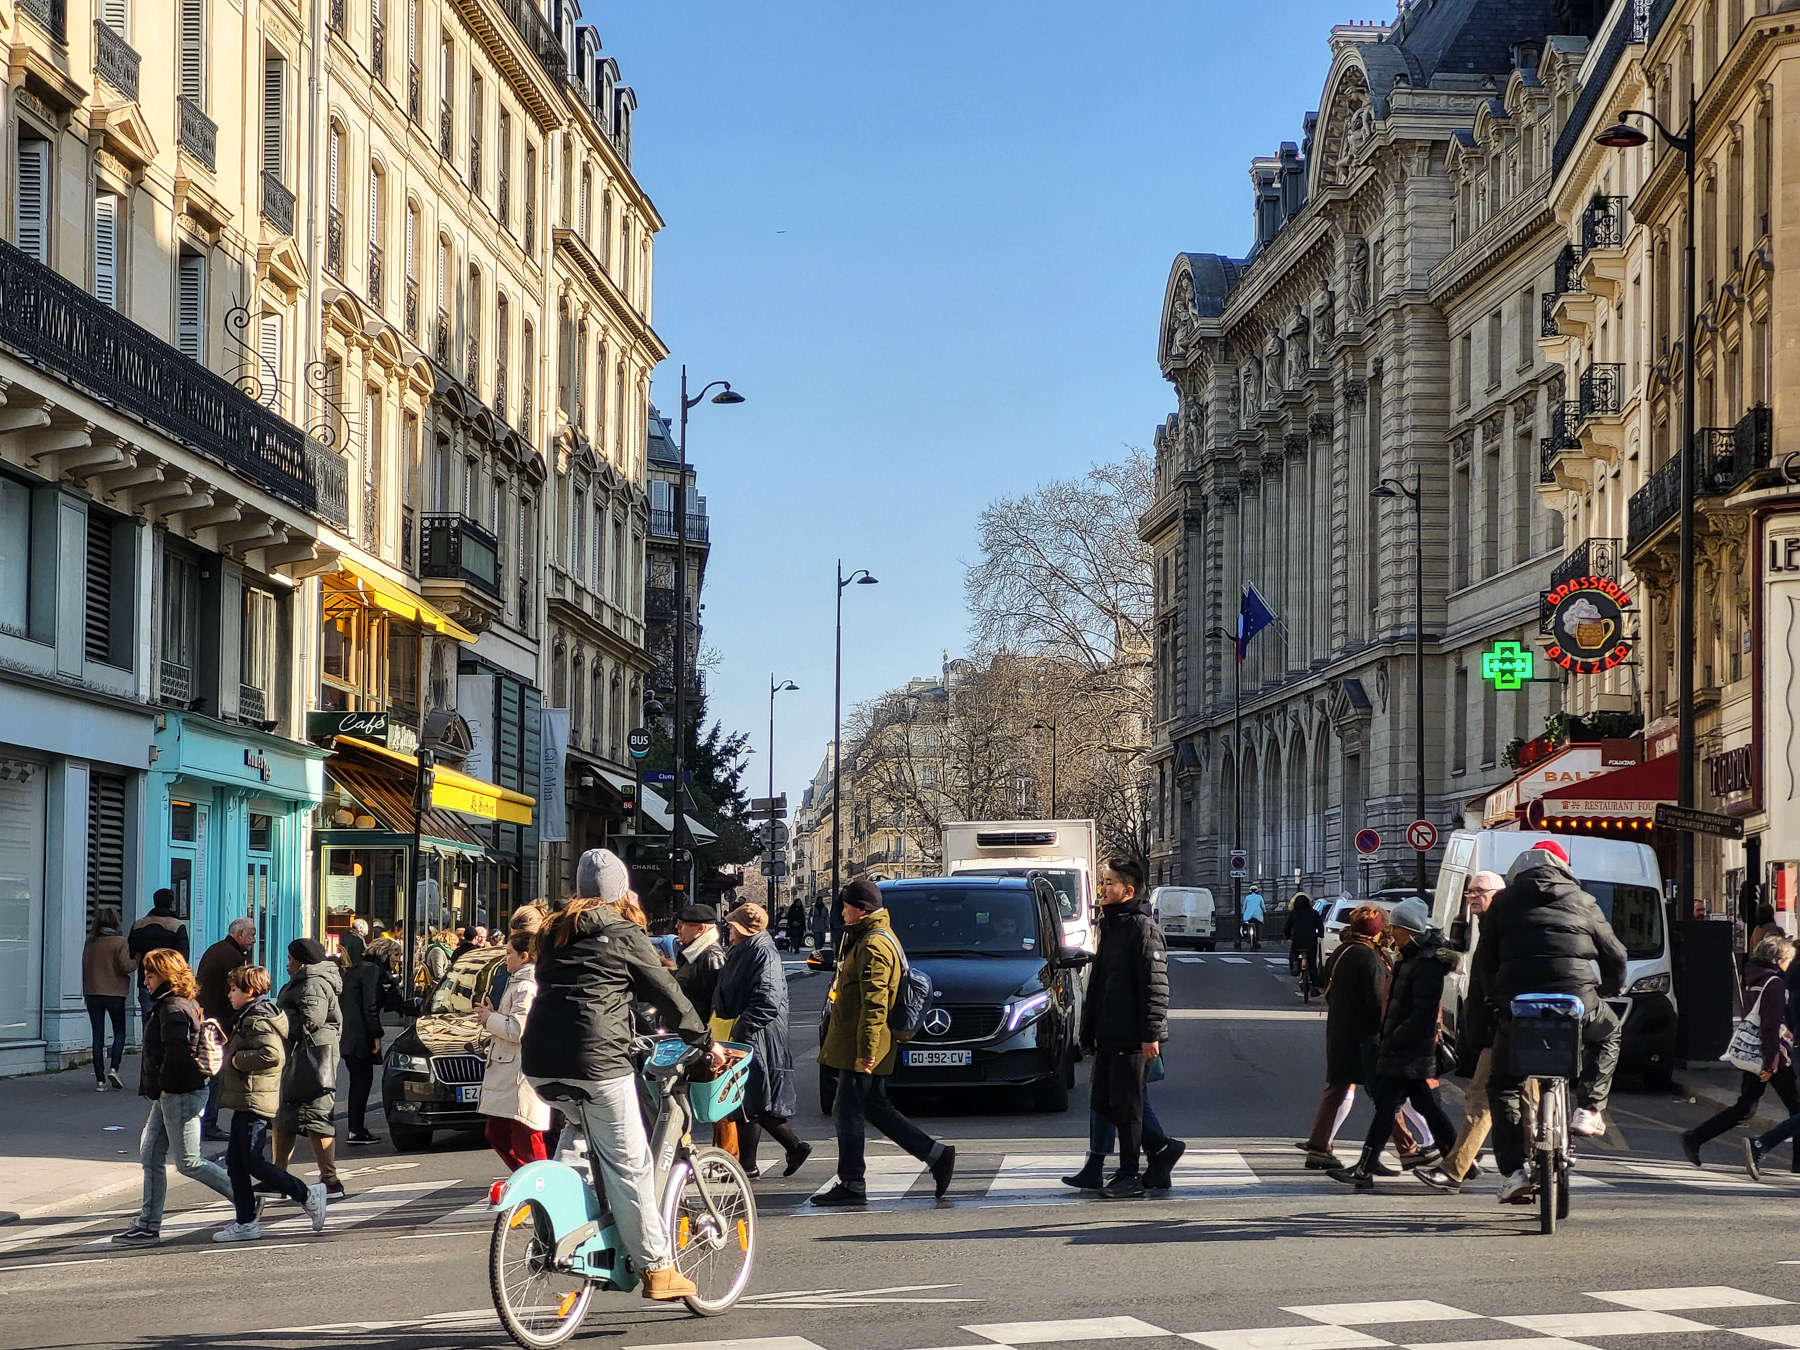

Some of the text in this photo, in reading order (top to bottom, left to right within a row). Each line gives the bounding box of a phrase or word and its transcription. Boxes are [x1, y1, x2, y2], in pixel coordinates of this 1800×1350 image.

[1769, 538, 1800, 571] LE
[1546, 576, 1630, 606] BRASSERIE
[1547, 645, 1628, 674] BALZAR
[338, 713, 387, 734] Café
[630, 735, 649, 745] BUS
[543, 747, 558, 801] Café Maa
[658, 773, 675, 781] Cluny
[1544, 771, 1614, 782] BALZ
[470, 794, 477, 812] Le
[623, 801, 633, 809] 86
[1584, 801, 1634, 811] RESTAURANT
[1677, 818, 1704, 830] QUARTIER
